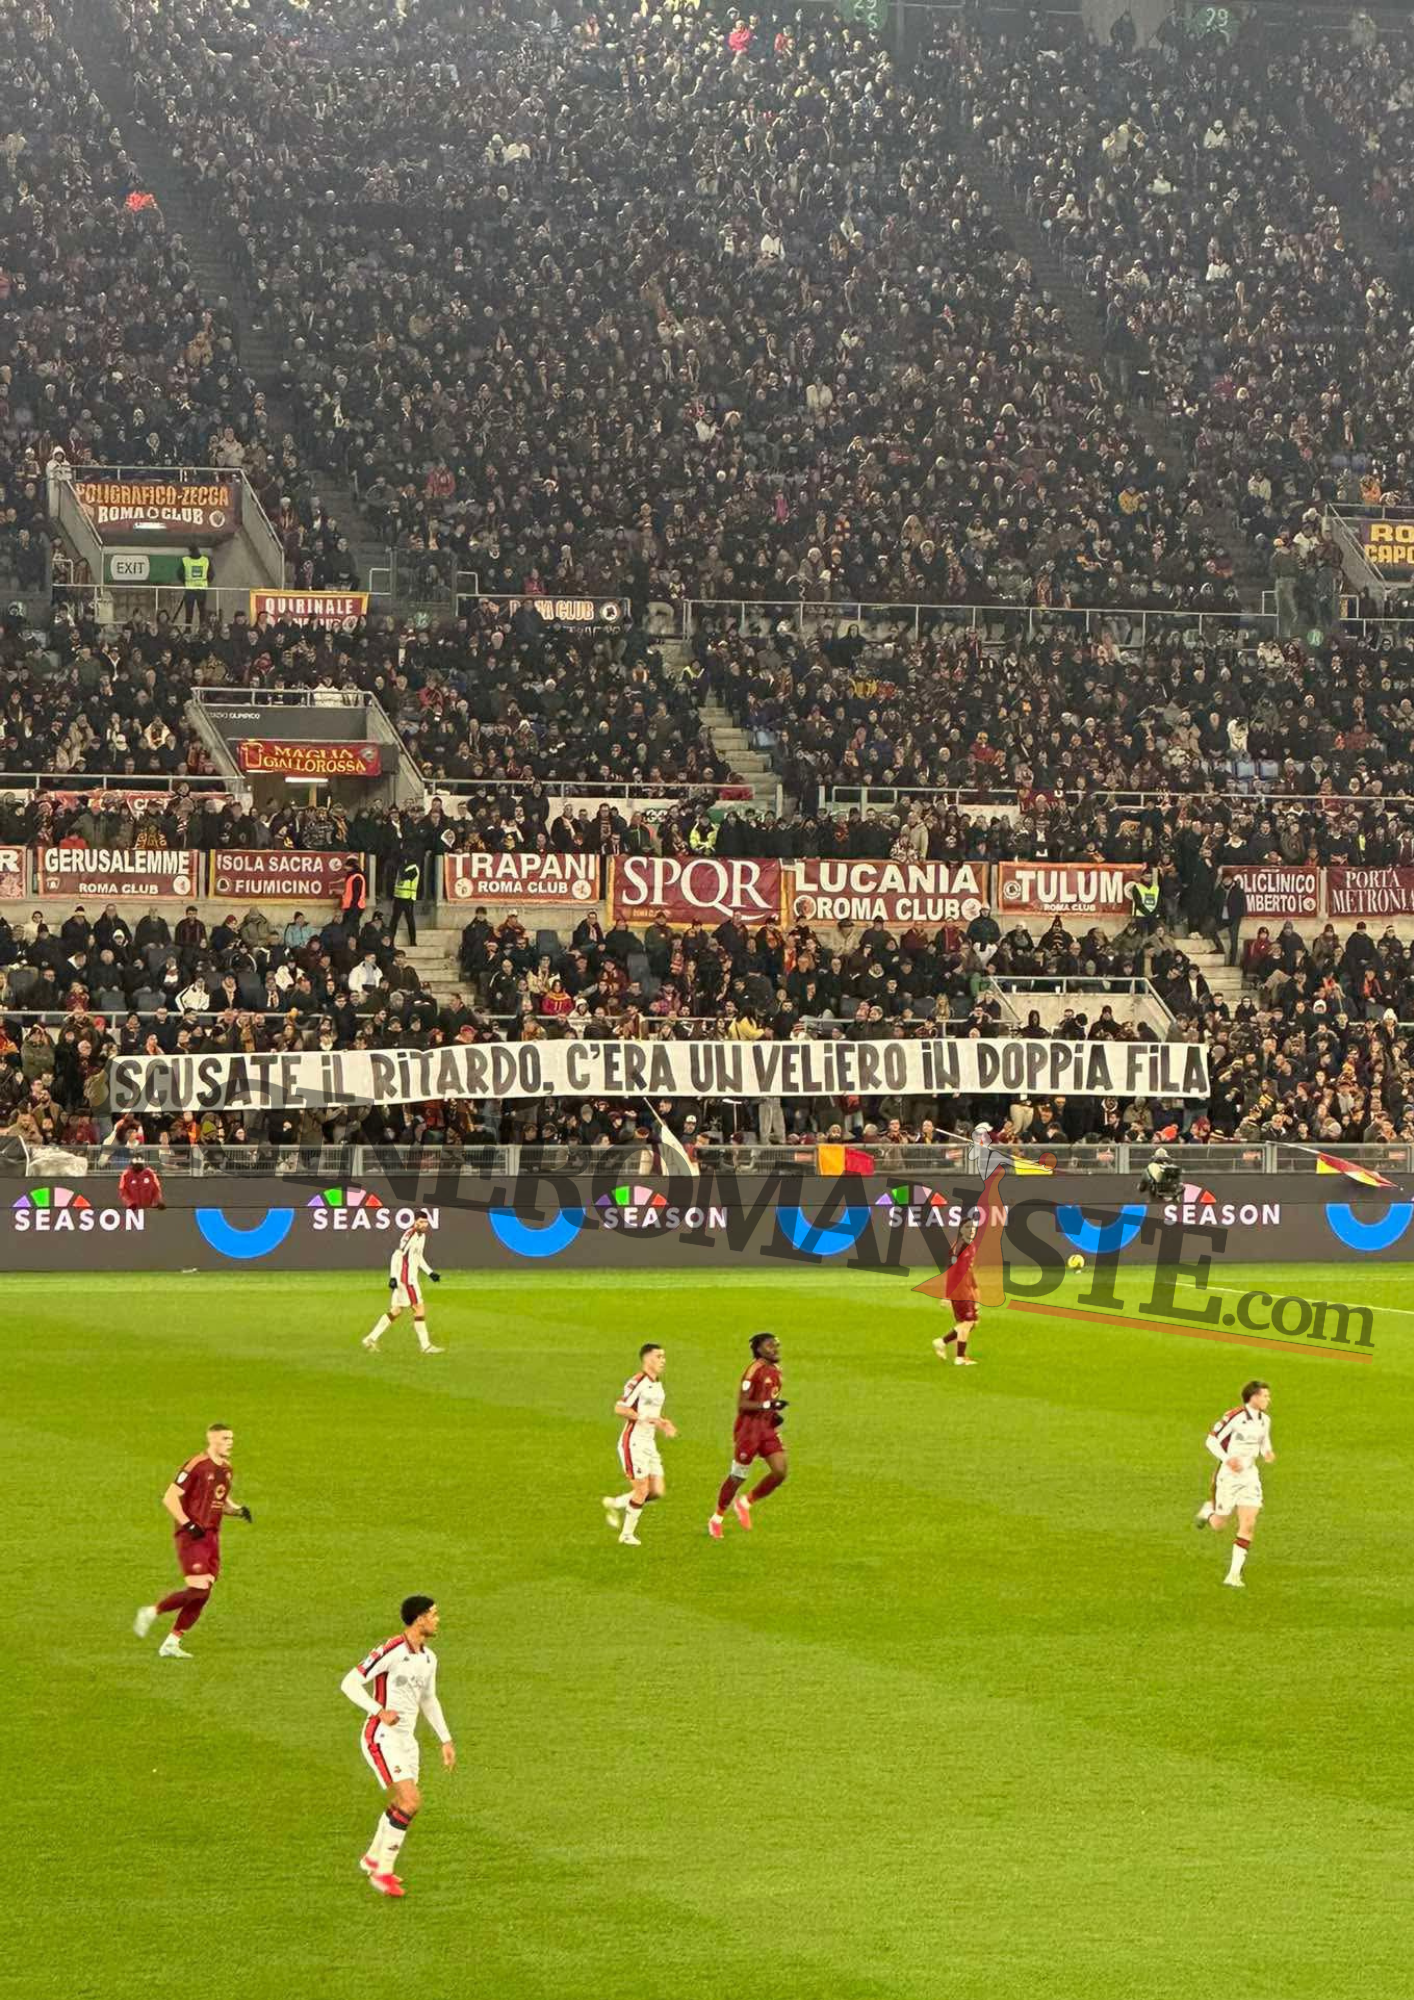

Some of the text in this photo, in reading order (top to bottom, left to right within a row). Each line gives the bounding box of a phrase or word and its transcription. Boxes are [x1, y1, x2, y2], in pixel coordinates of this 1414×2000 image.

[98, 506, 204, 525] ROMA CLUB
[116, 562, 145, 574] EXIT
[265, 597, 354, 615] QUIRINALE
[555, 600, 594, 620] CLUB
[274, 745, 354, 759] MAGLIA
[263, 756, 367, 773] GIALLOROSSA
[45, 849, 190, 874] GERUSALEMME
[217, 854, 324, 872] ISOLA SACRA
[448, 852, 595, 880] TRAPANI
[235, 880, 323, 894] FIUMICINO
[478, 881, 568, 893] ROMA CLUB
[795, 862, 980, 893] LUCANIA
[1015, 870, 1124, 903] TULUM
[1234, 873, 1316, 893] OLICLINICO
[1346, 868, 1401, 888] PORTA
[79, 883, 158, 894] ROMA CLUB
[622, 856, 773, 920] SPQR
[817, 898, 961, 921] ROMA CLUB
[1246, 894, 1296, 912] MBERTO
[115, 1055, 305, 1108] SCUSATE
[566, 1043, 677, 1092] C'ERA
[689, 1043, 743, 1092] UN
[14, 1208, 145, 1231] SEASON
[312, 1208, 440, 1231] SEASON
[603, 1206, 728, 1229] SEASON
[1163, 1203, 1280, 1225] SEASON
